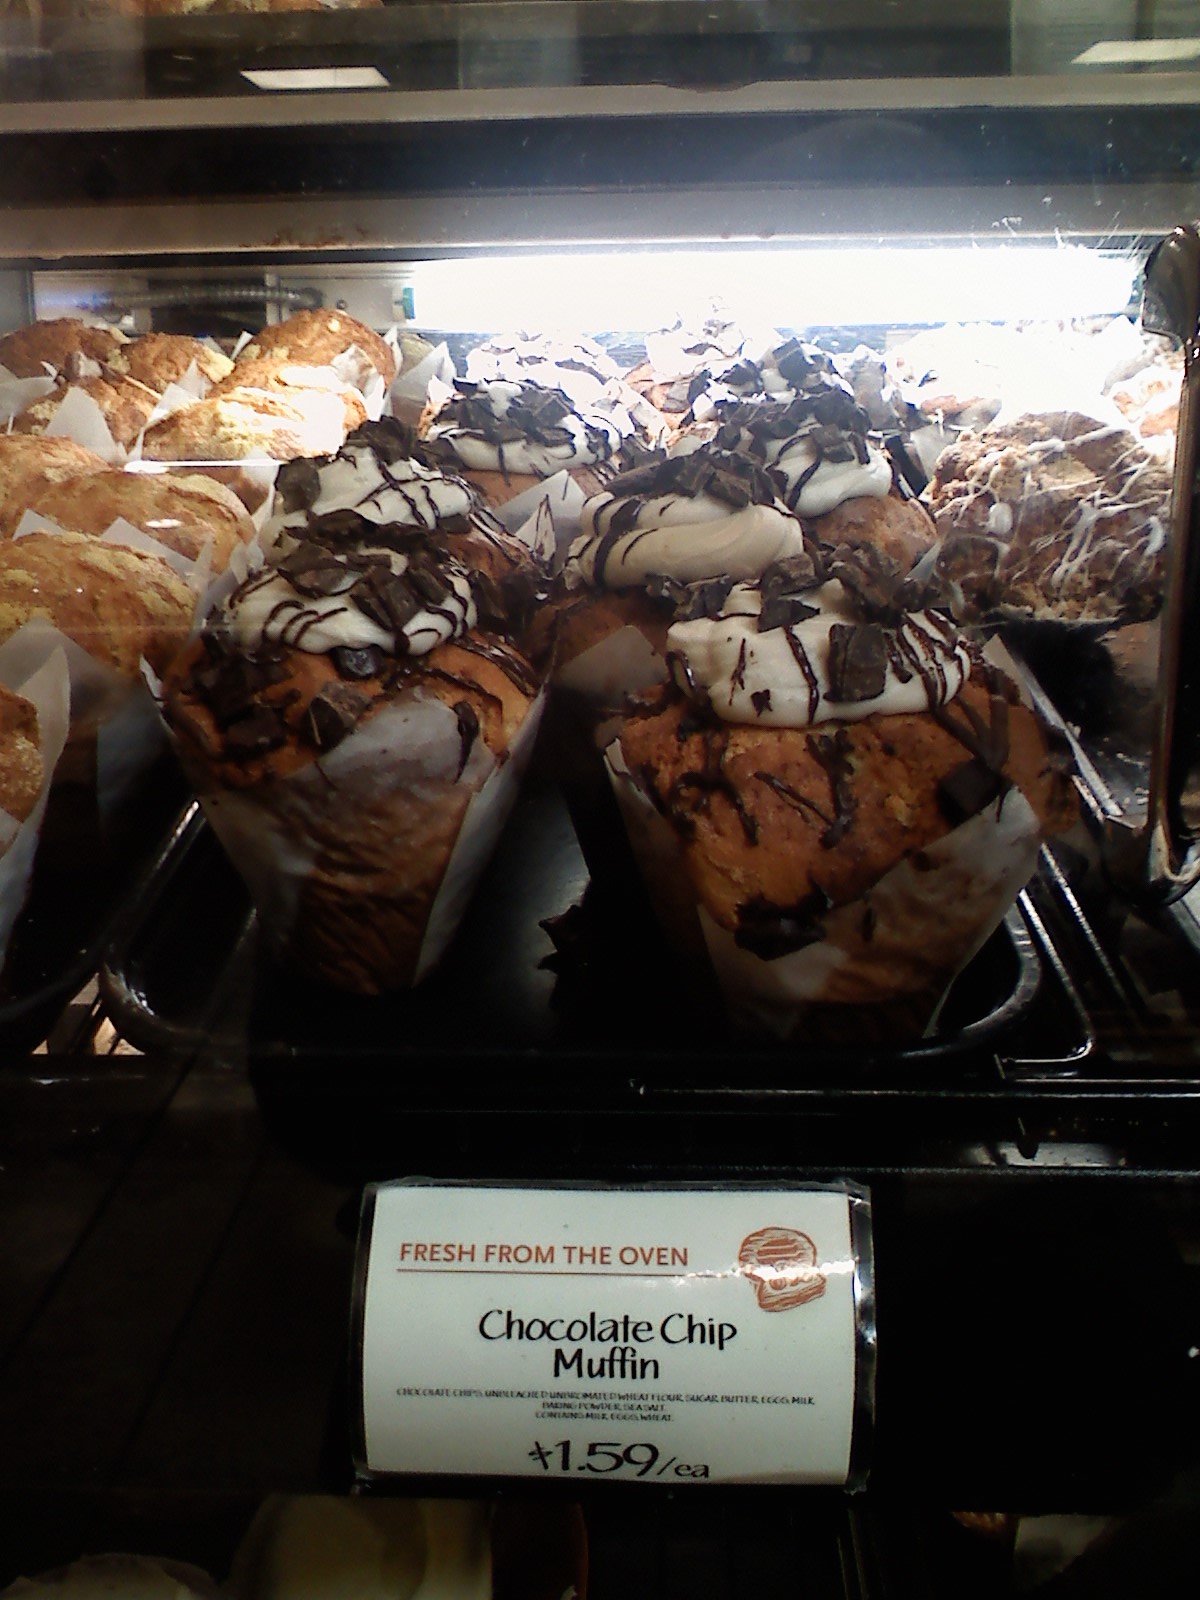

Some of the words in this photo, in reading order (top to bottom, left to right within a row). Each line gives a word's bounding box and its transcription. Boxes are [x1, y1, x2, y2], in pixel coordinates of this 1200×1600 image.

[400, 1243, 475, 1262] FRESH
[484, 1244, 555, 1264] FROM
[563, 1245, 612, 1265] THE
[618, 1246, 689, 1266] OVEN
[478, 1308, 654, 1343] Chocolate
[660, 1313, 737, 1350] Chip
[552, 1346, 660, 1379] Muffin
